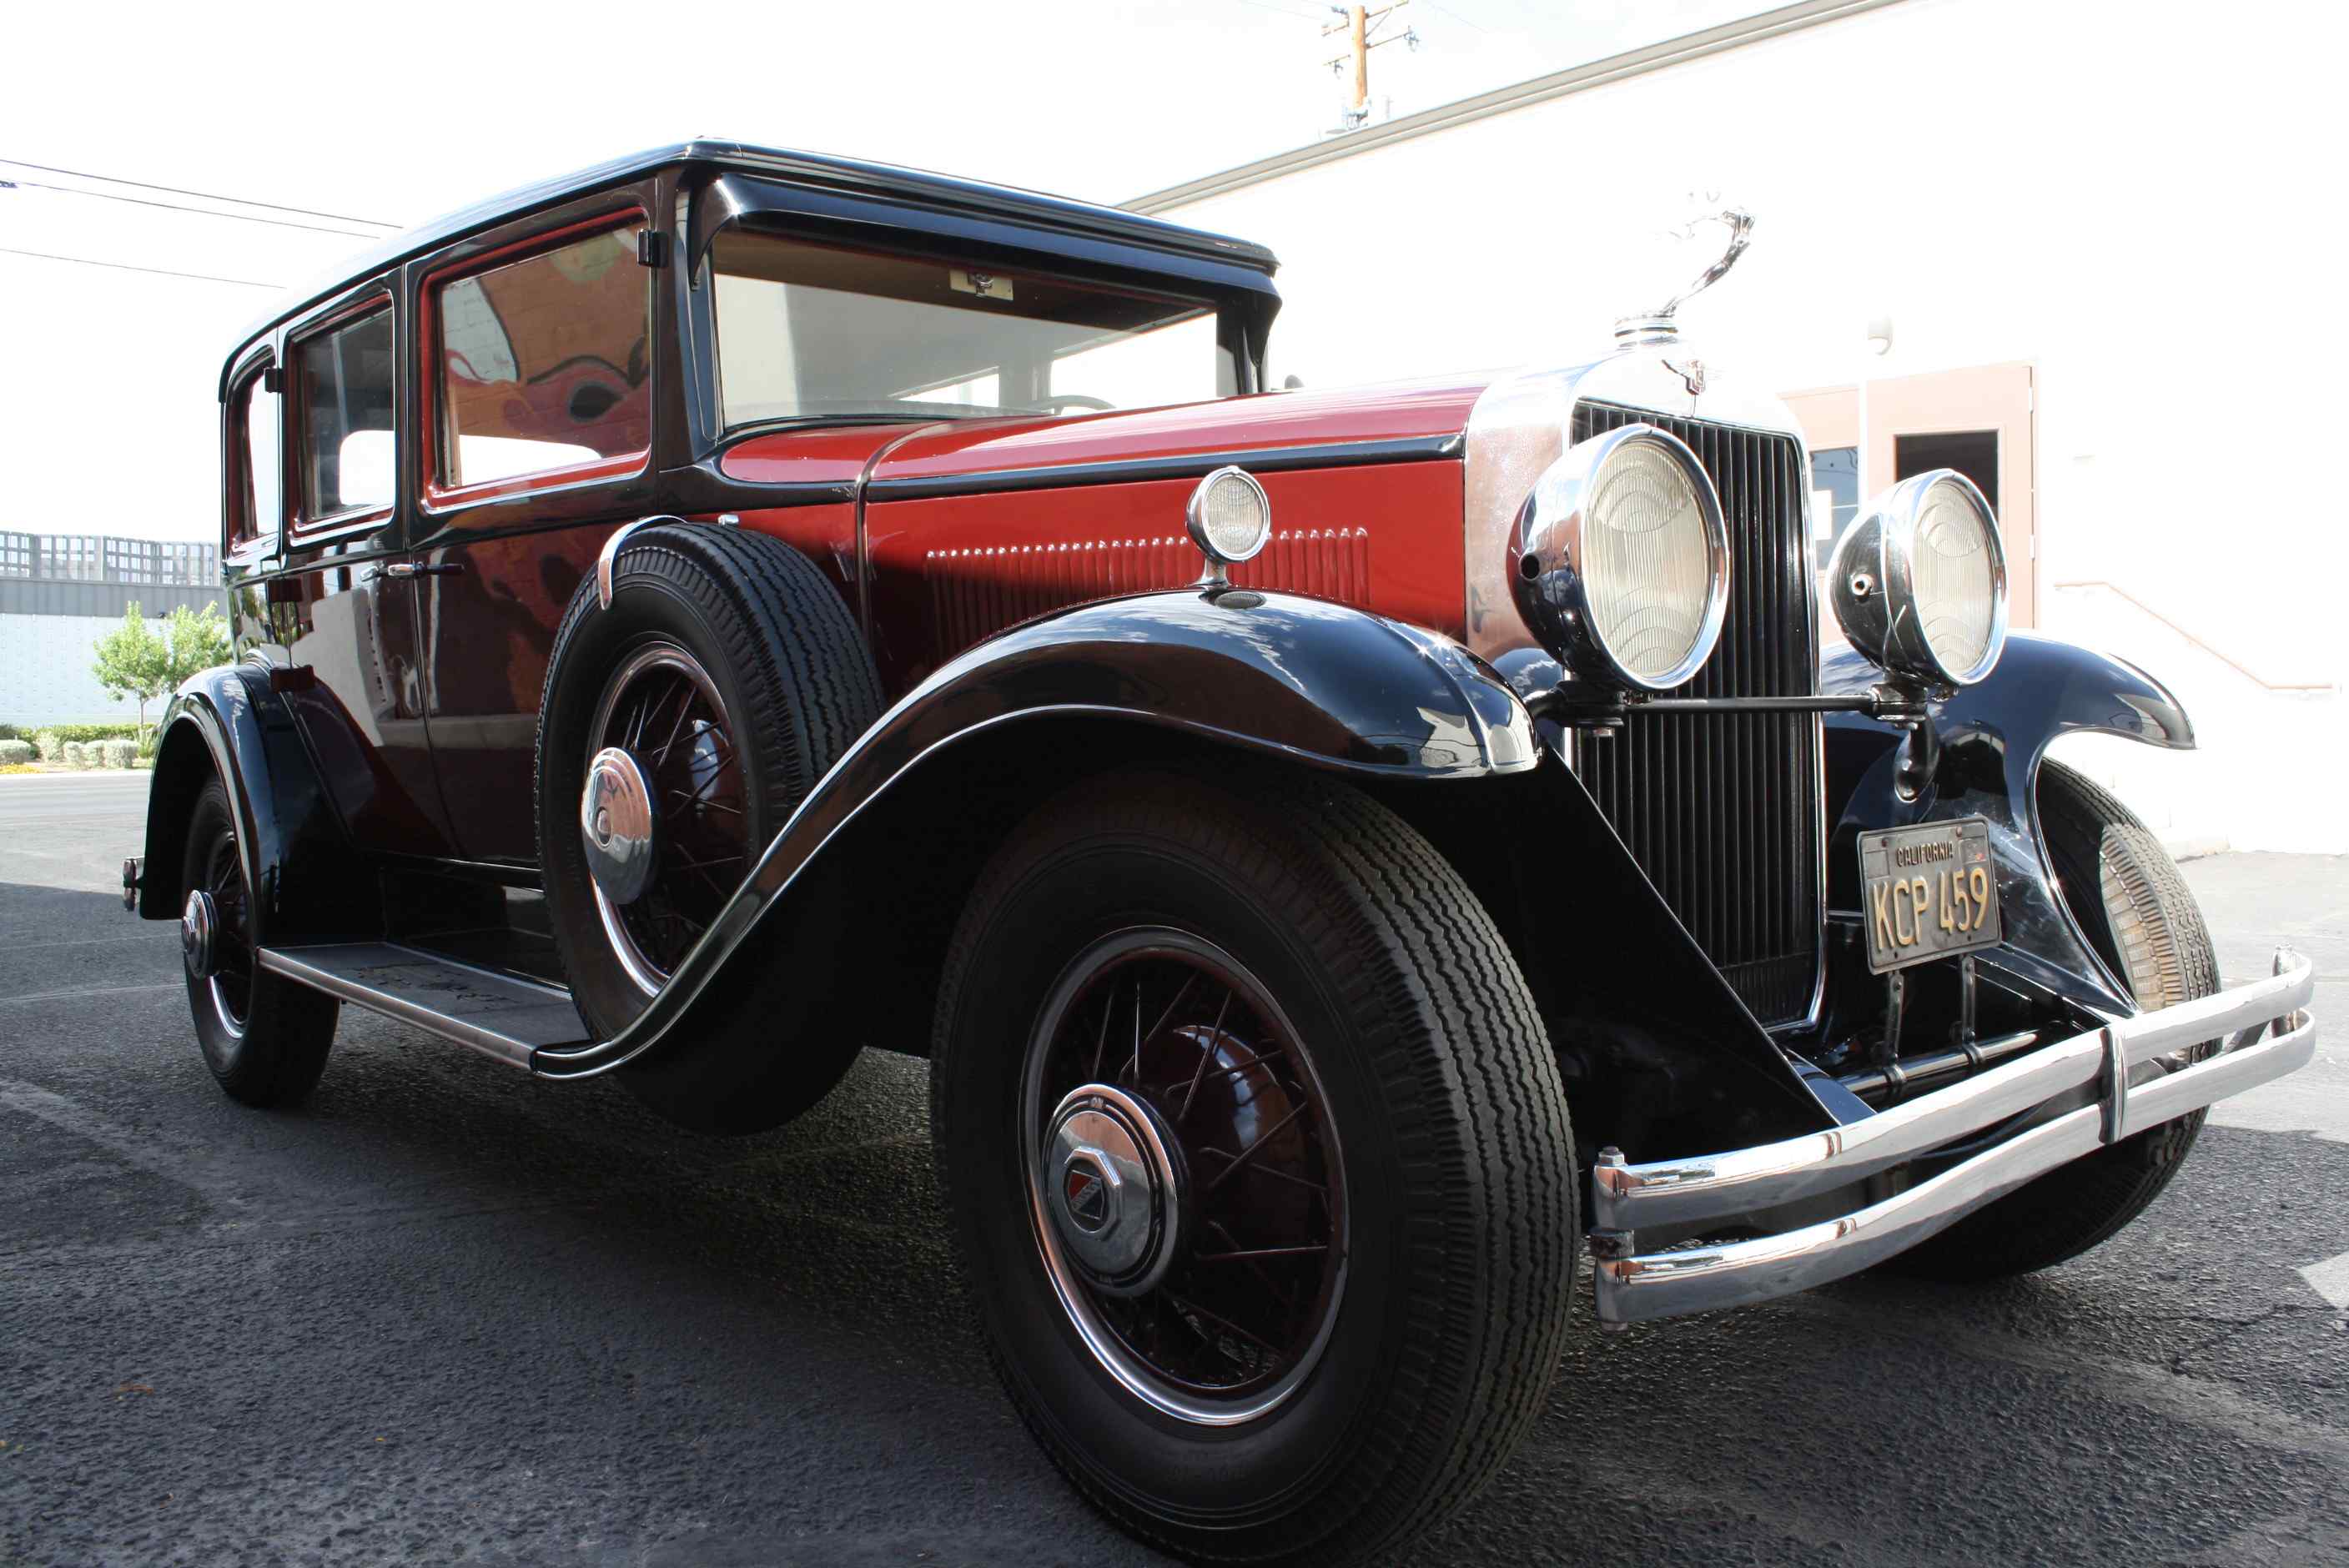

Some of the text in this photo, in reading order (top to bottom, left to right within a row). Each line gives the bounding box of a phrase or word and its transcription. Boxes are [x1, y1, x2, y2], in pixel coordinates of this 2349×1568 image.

[1897, 842, 1954, 867] CALIFORNIA
[1874, 867, 1989, 952] KCP 459
